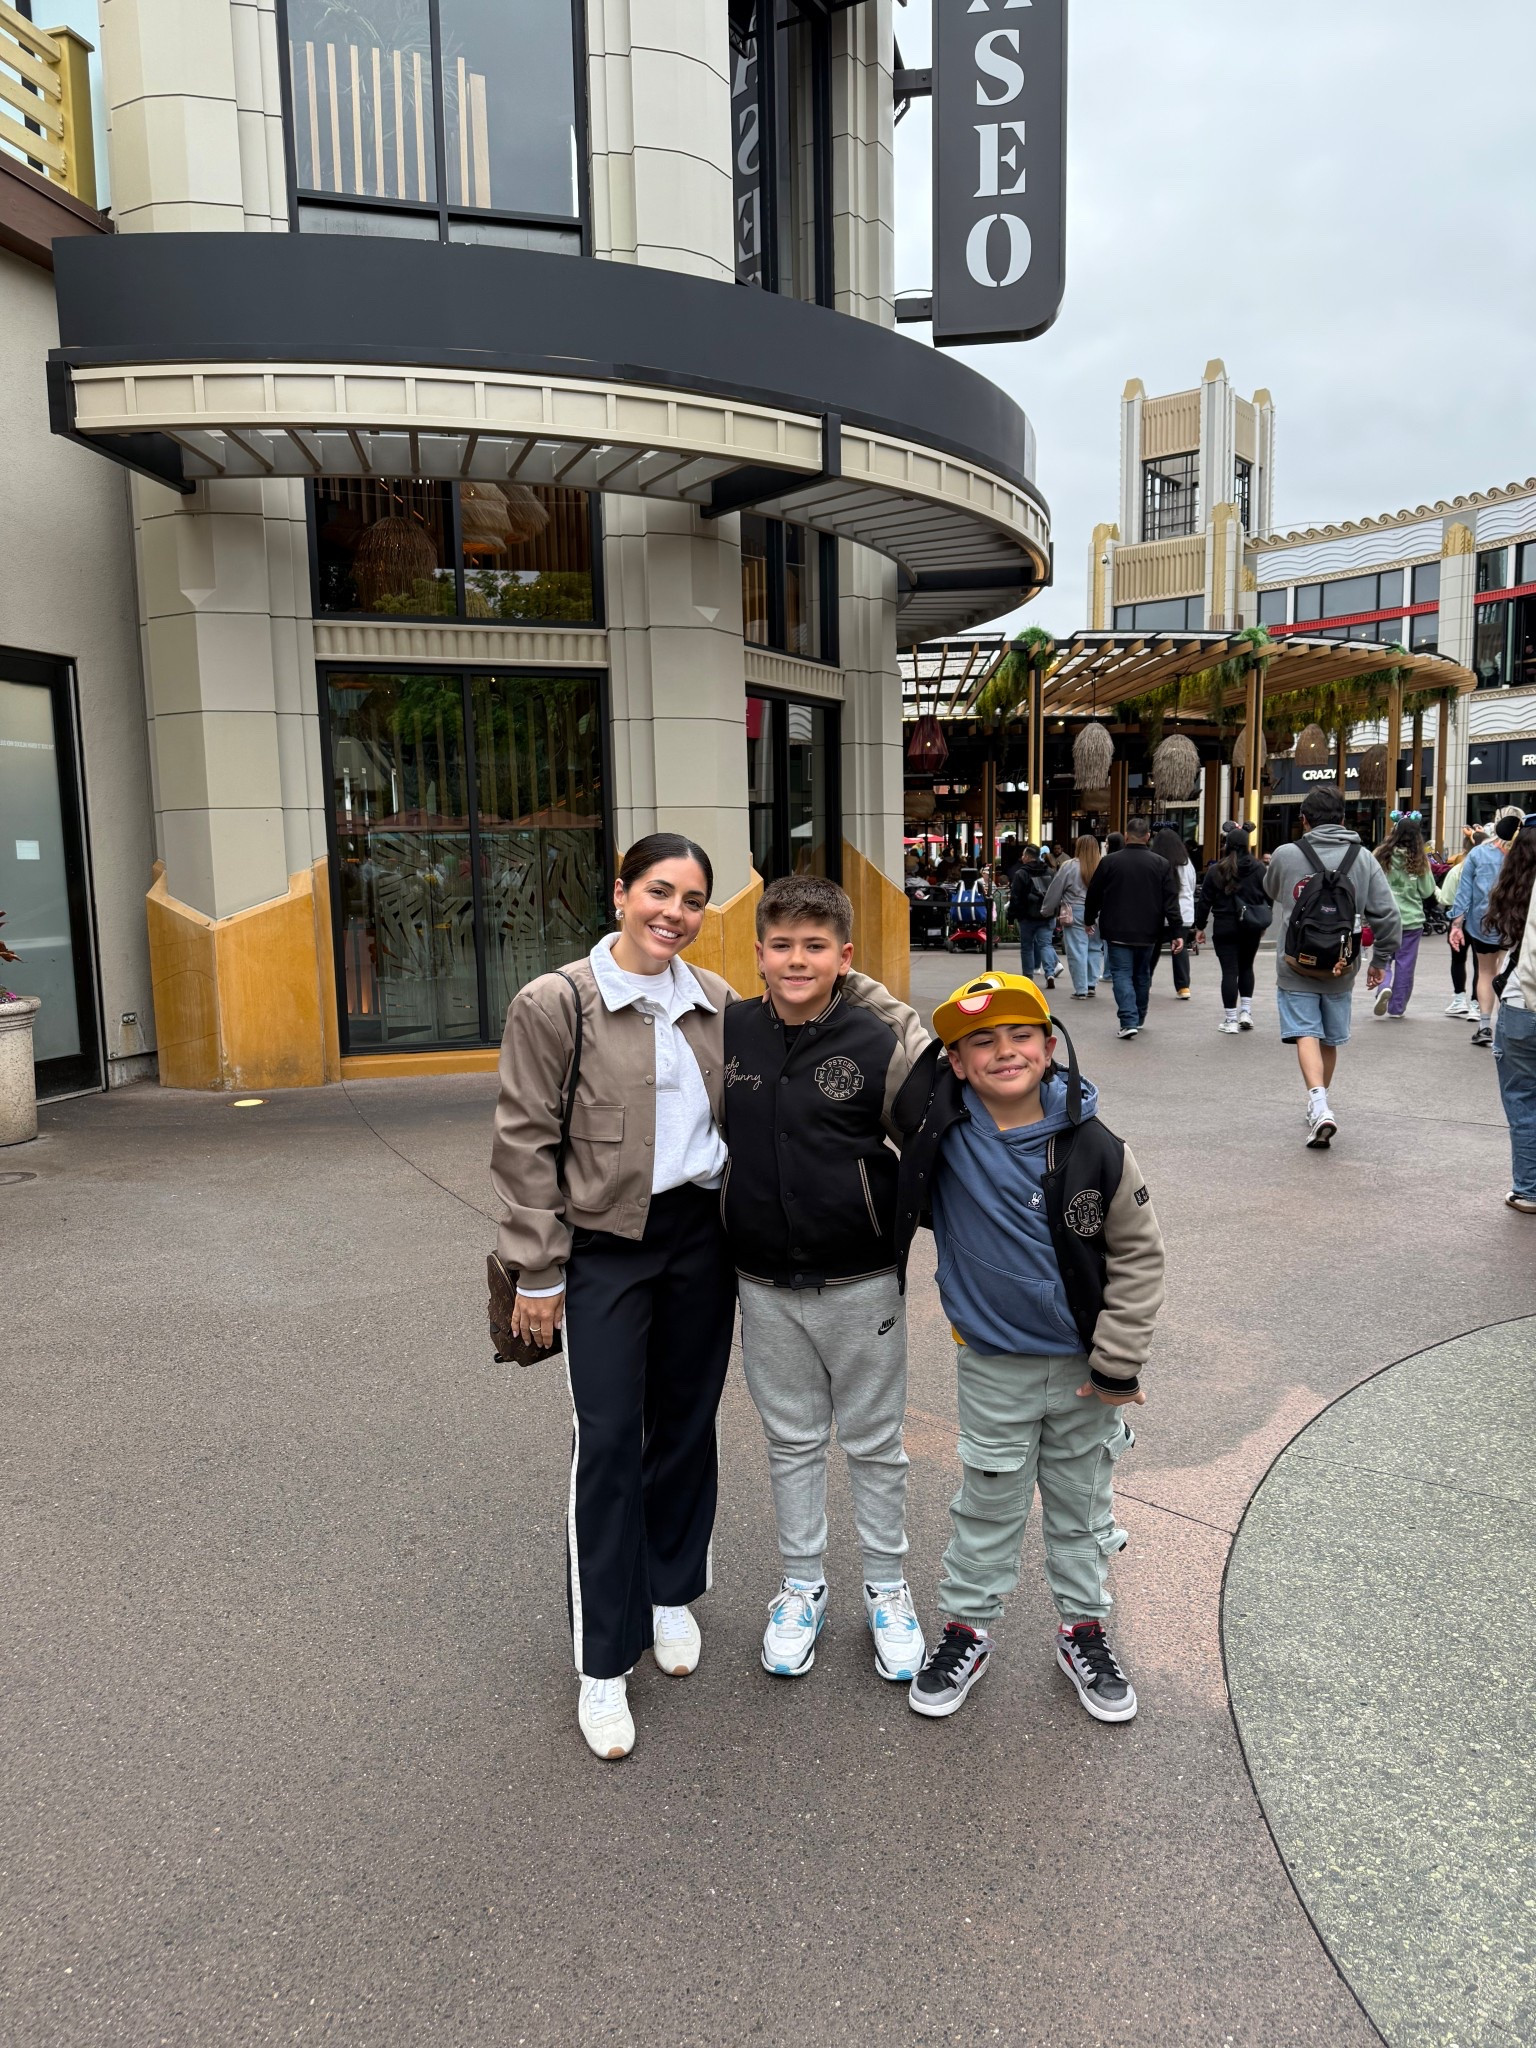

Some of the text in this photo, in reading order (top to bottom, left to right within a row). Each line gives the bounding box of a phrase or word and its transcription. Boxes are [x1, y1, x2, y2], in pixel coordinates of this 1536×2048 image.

[966, 0, 1033, 288] SEO
[1521, 753, 1536, 766] FR
[1302, 768, 1337, 781] CRAZY
[827, 1059, 856, 1072] PSYCHO
[727, 1068, 763, 1091] Bunny
[823, 1085, 851, 1098] BUNNY
[1072, 1192, 1099, 1208] PSYCHO
[881, 1315, 896, 1330] NIKE
